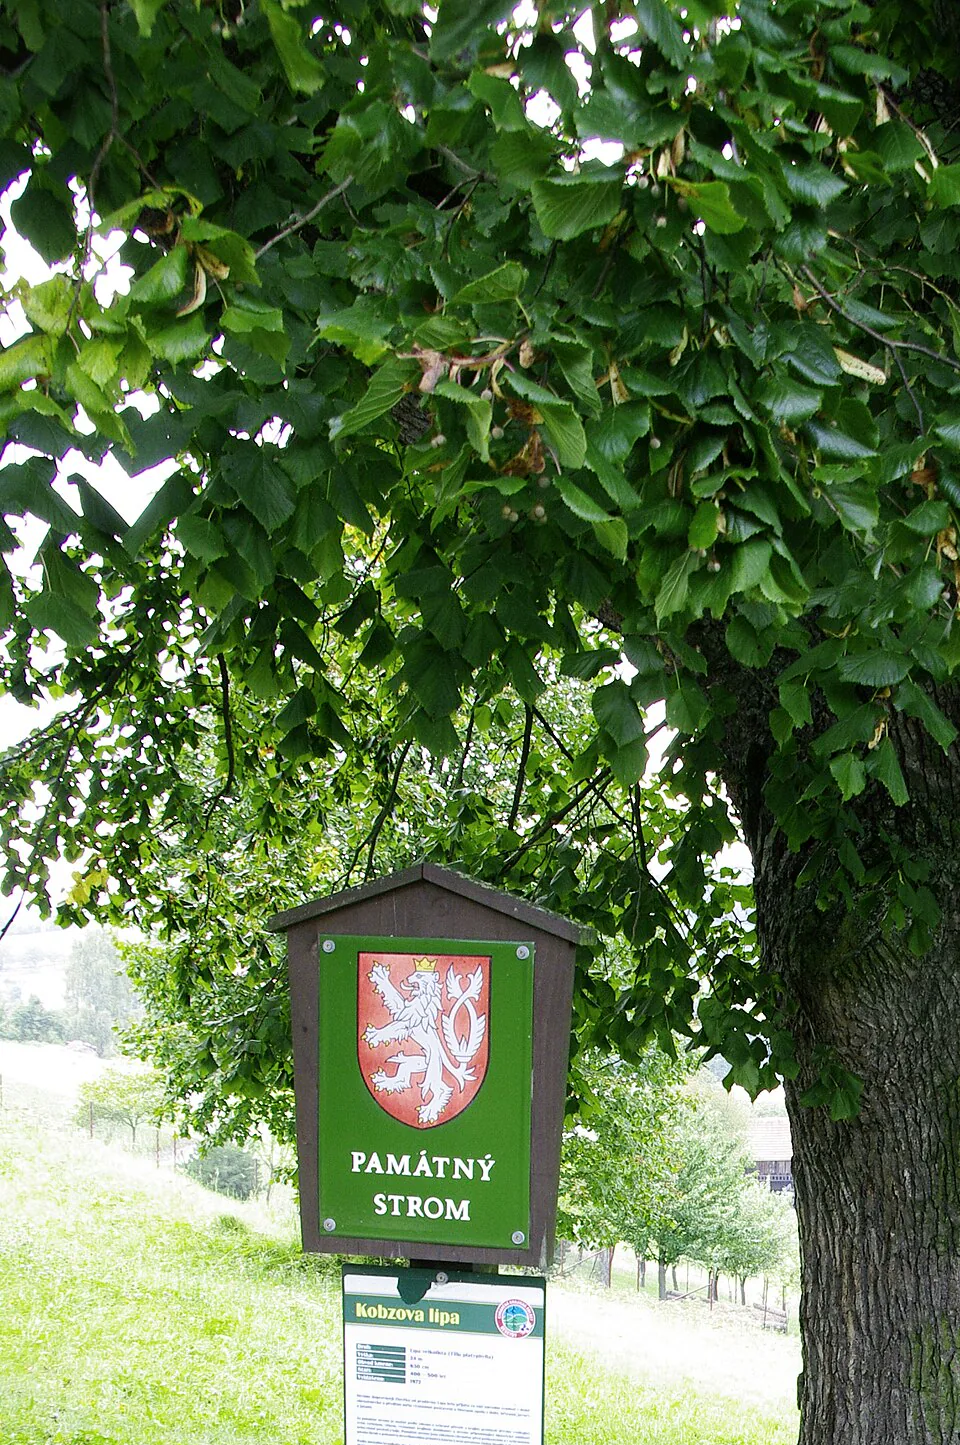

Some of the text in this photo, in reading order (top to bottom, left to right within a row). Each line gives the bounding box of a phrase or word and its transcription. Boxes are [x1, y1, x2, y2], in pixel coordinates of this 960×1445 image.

[350, 1149, 496, 1182] PAMÁTNÝ
[373, 1193, 471, 1222] STROM
[355, 1302, 425, 1323] Kobzova
